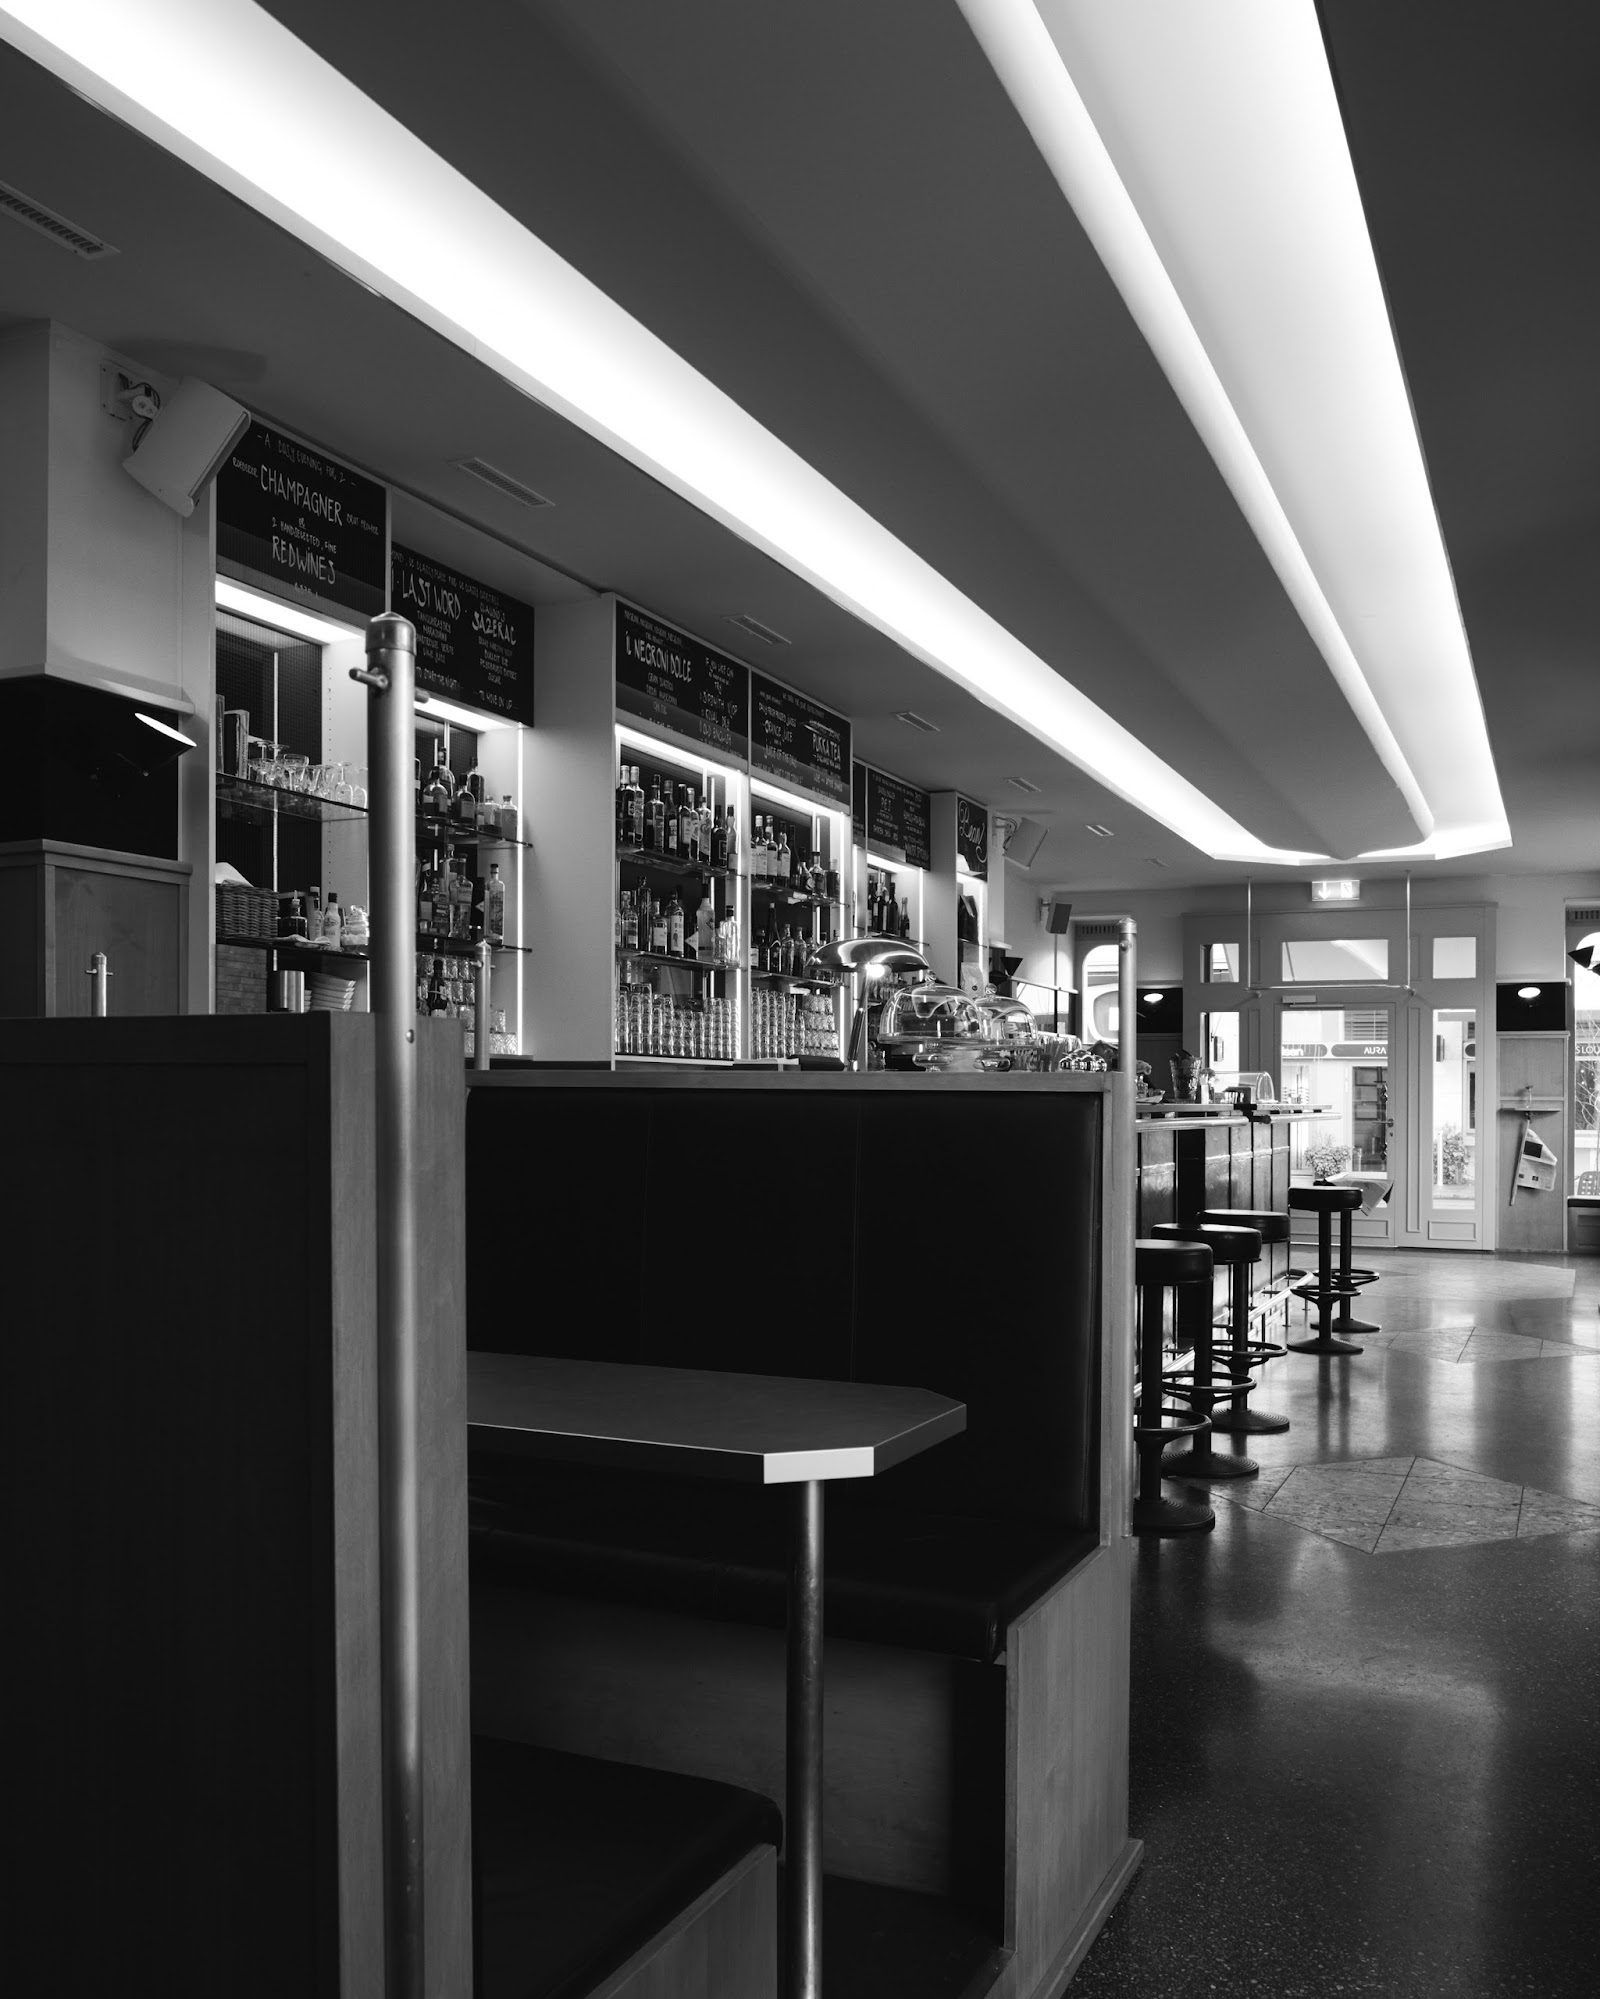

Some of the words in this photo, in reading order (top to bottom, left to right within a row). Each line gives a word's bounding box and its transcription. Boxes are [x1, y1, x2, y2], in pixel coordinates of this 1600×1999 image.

[260, 463, 343, 527] CHAMPAGNER
[272, 535, 336, 585] REDWINES
[402, 569, 431, 608] LAST
[433, 584, 461, 621] WORD
[472, 610, 517, 646] SAZERAC
[634, 638, 669, 673] NEGRONI
[670, 653, 692, 683] DOLCE
[830, 739, 842, 763] TEA
[1364, 1047, 1386, 1055] AURA
